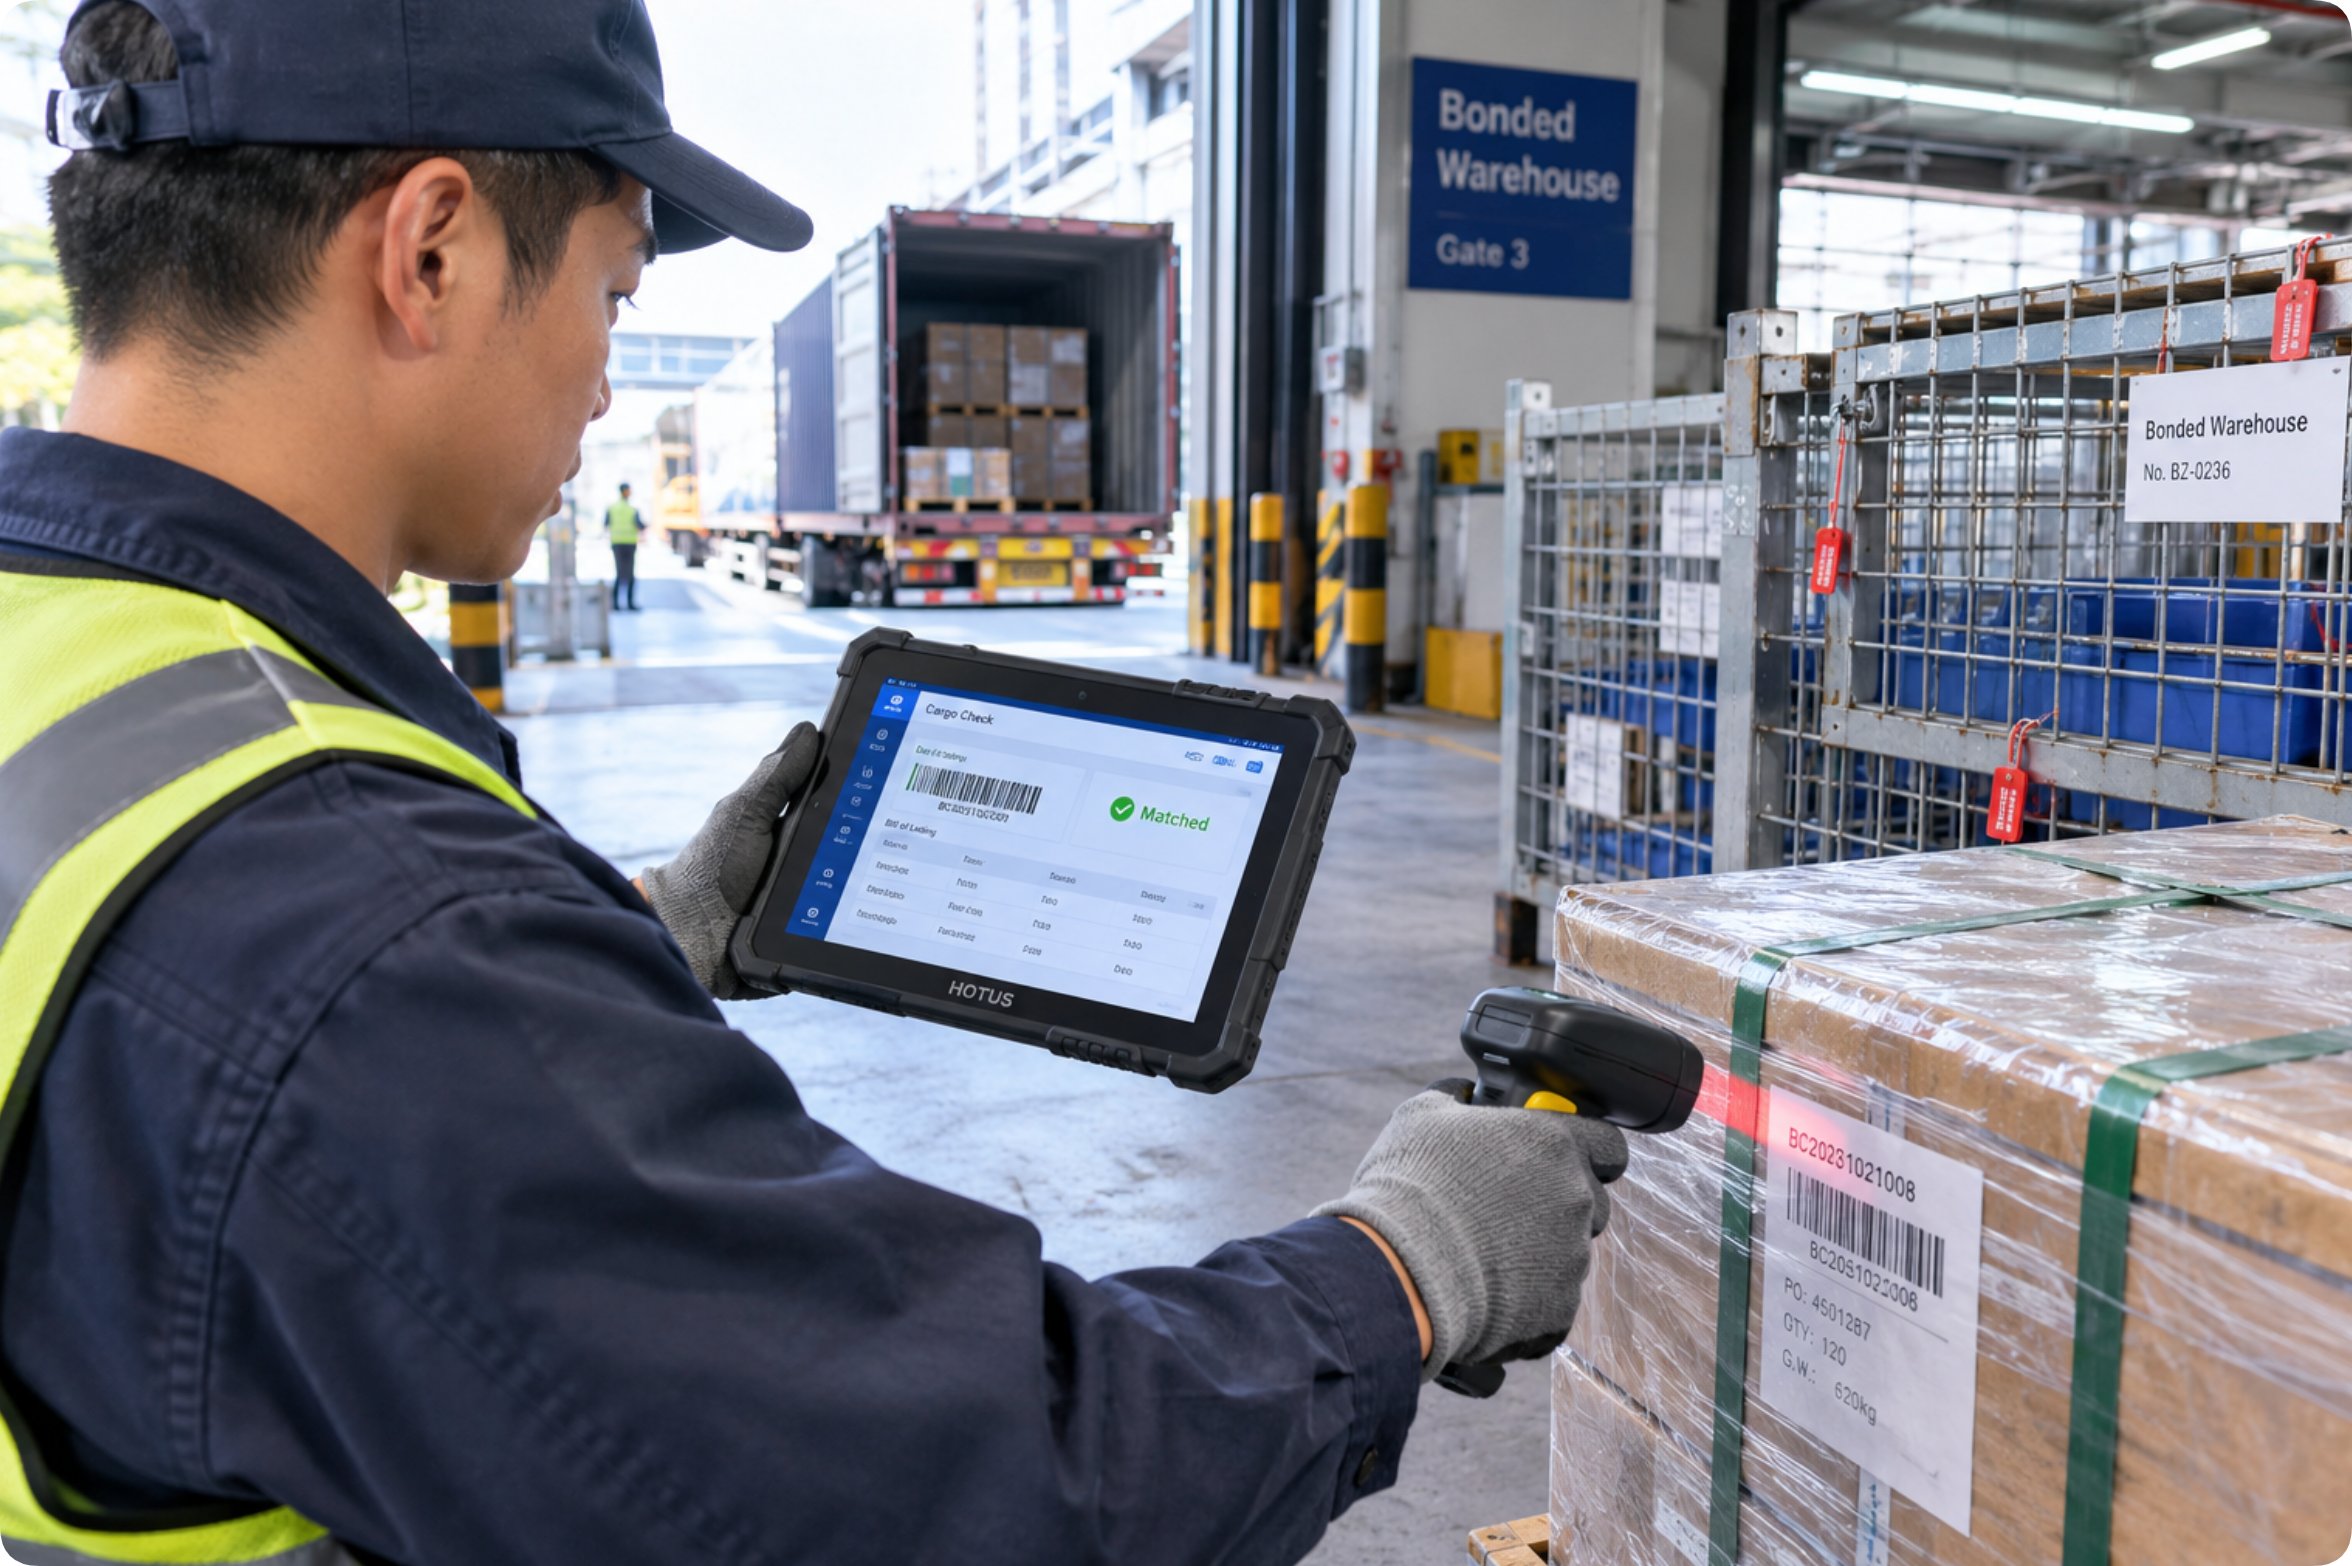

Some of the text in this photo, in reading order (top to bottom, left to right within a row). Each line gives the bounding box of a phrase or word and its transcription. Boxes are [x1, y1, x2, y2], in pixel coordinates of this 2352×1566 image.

[1438, 87, 1576, 143] Bonded
[1436, 146, 1621, 204] Warehouse
[1435, 232, 1530, 270] Gate 3
[2145, 412, 2308, 441] Bonded Warehouse
[2143, 460, 2231, 482] No. BZ-0236
[925, 703, 995, 725] Cargo Check
[1139, 805, 1211, 832] Matched
[948, 979, 1015, 1008] HOTUS
[1788, 1126, 1916, 1203] BC20231021008
[1784, 1276, 1871, 1341] PO: 4501287
[1822, 1336, 1847, 1367] 120
[1834, 1381, 1877, 1426] 620kg
